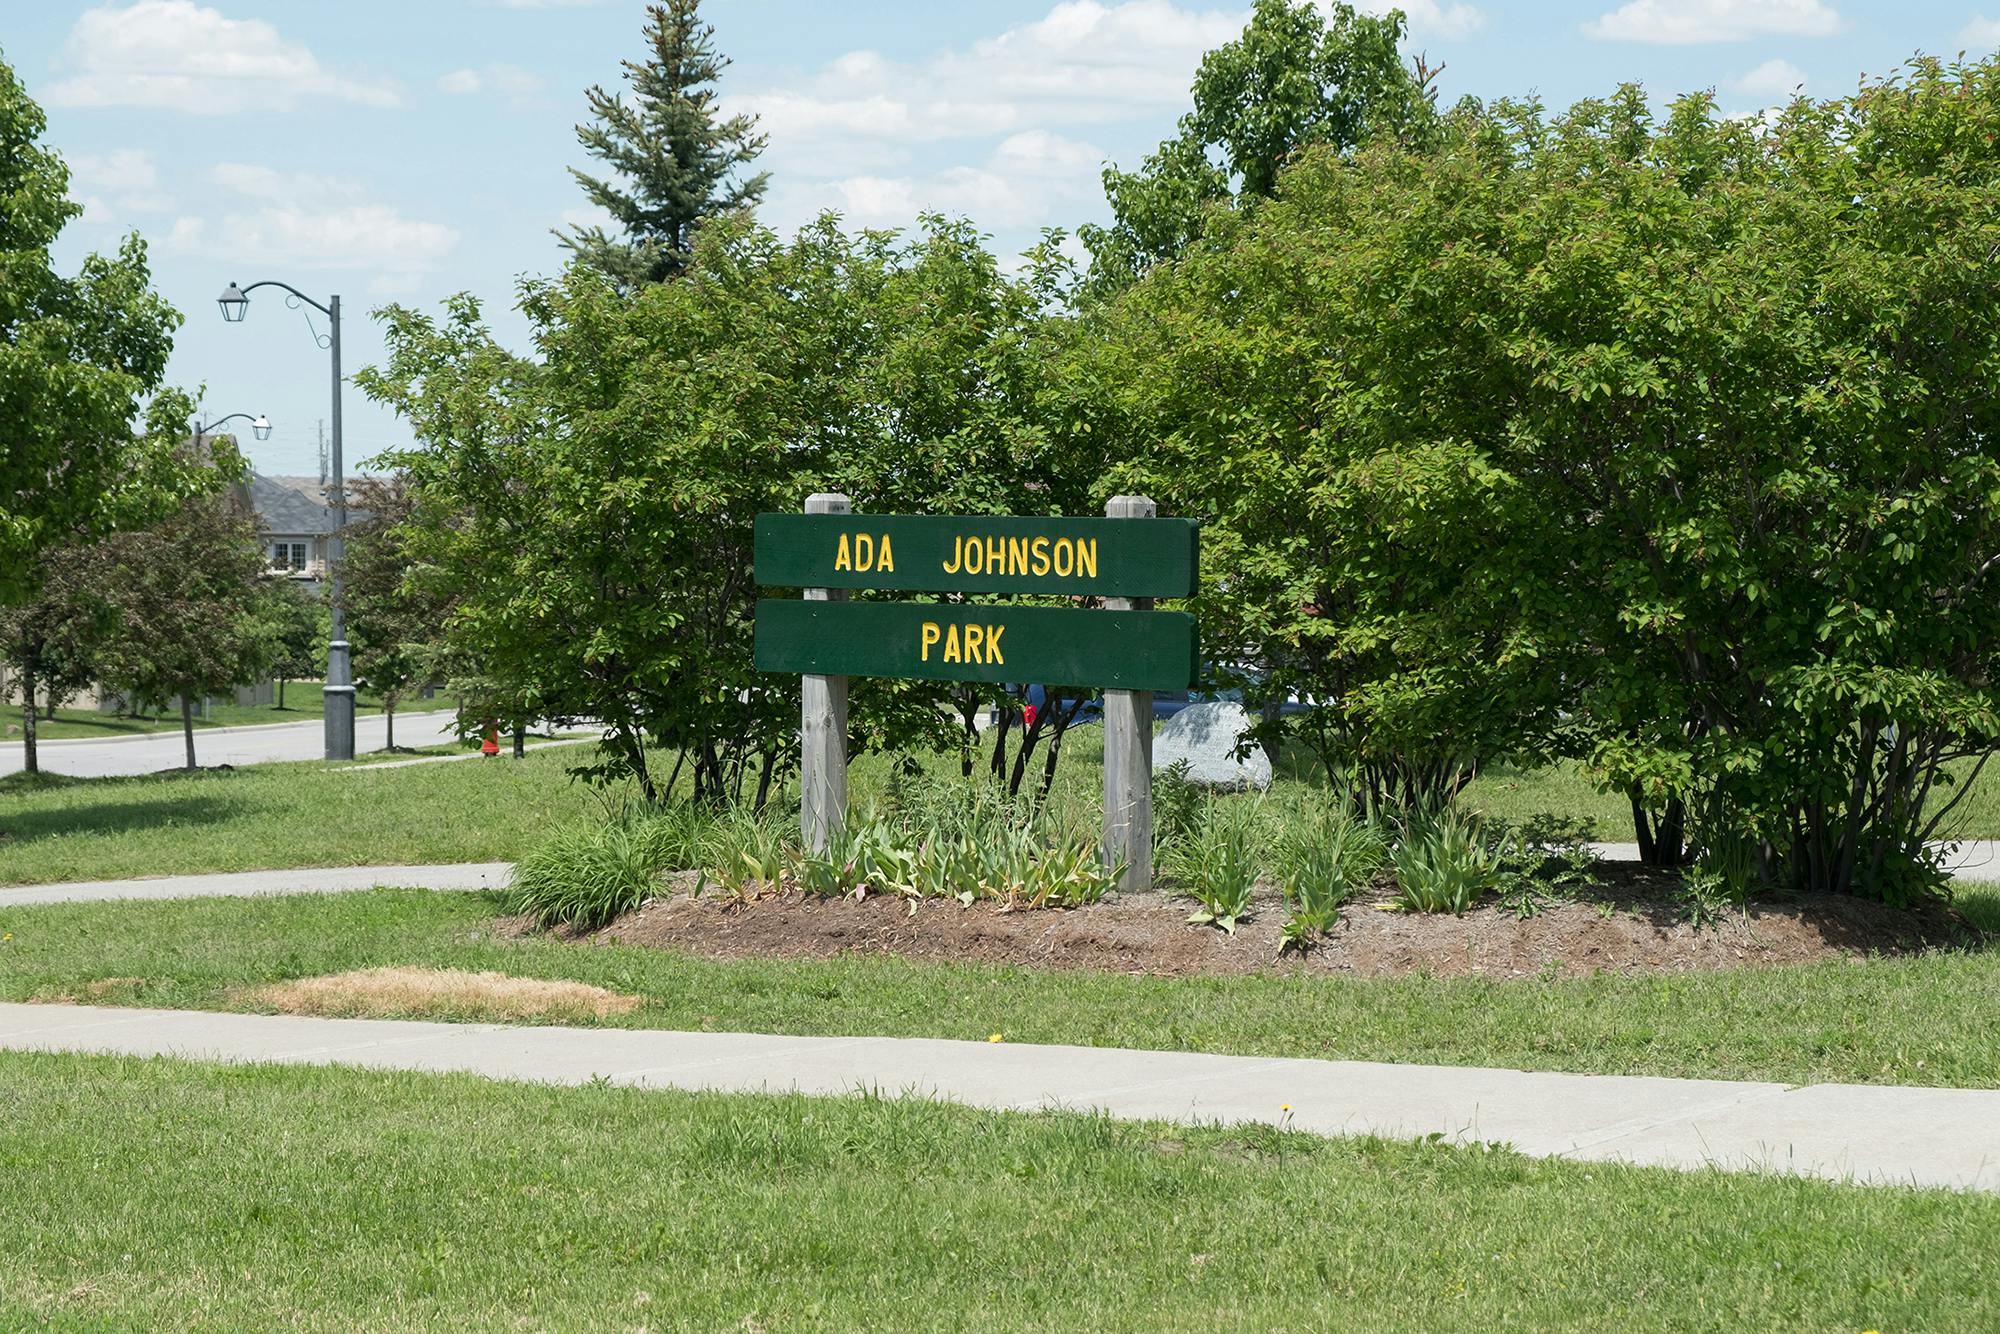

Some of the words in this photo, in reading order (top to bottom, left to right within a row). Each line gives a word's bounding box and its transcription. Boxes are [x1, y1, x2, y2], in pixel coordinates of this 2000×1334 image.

[834, 533, 895, 572] ADA
[942, 535, 1098, 577] JOHNSON
[920, 622, 1006, 664] PARK
